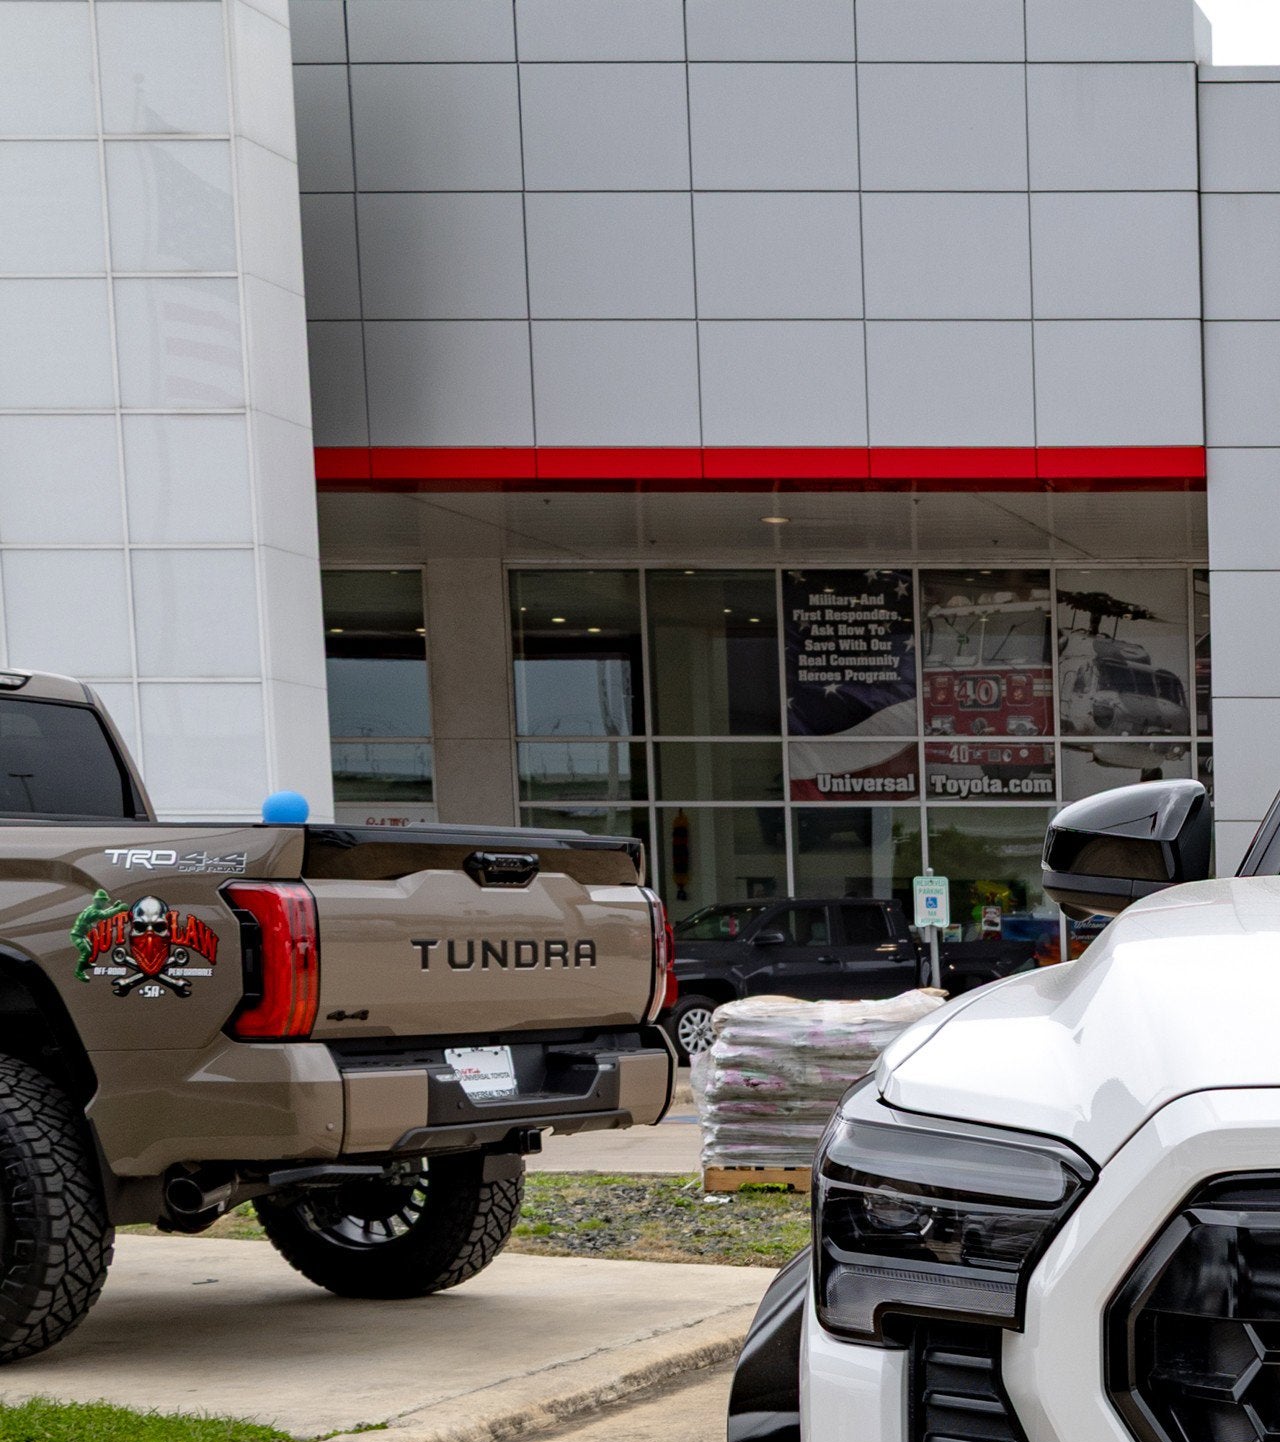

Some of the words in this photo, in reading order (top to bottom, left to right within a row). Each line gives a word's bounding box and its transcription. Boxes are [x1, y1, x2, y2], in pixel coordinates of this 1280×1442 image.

[808, 594, 857, 608] Military
[860, 594, 885, 605] And
[792, 609, 822, 621] First
[810, 624, 835, 636] Ask
[837, 624, 865, 636] How
[868, 624, 886, 635] To
[804, 639, 836, 651] Save
[838, 639, 868, 651] With
[870, 639, 892, 651] Our
[798, 655, 827, 666] Real
[829, 654, 900, 668] Community
[798, 670, 841, 681] Heroes
[844, 669, 902, 684] Program.
[956, 679, 998, 706] 40
[949, 745, 969, 762] 40
[816, 773, 916, 793] Universal
[930, 774, 1054, 798] Toyota.com
[104, 849, 178, 870] TRD
[167, 910, 220, 966] LAW
[410, 939, 597, 972] TUNDRA
[93, 967, 127, 976] OFF-ROAD
[167, 967, 214, 977] PERFORMANCE
